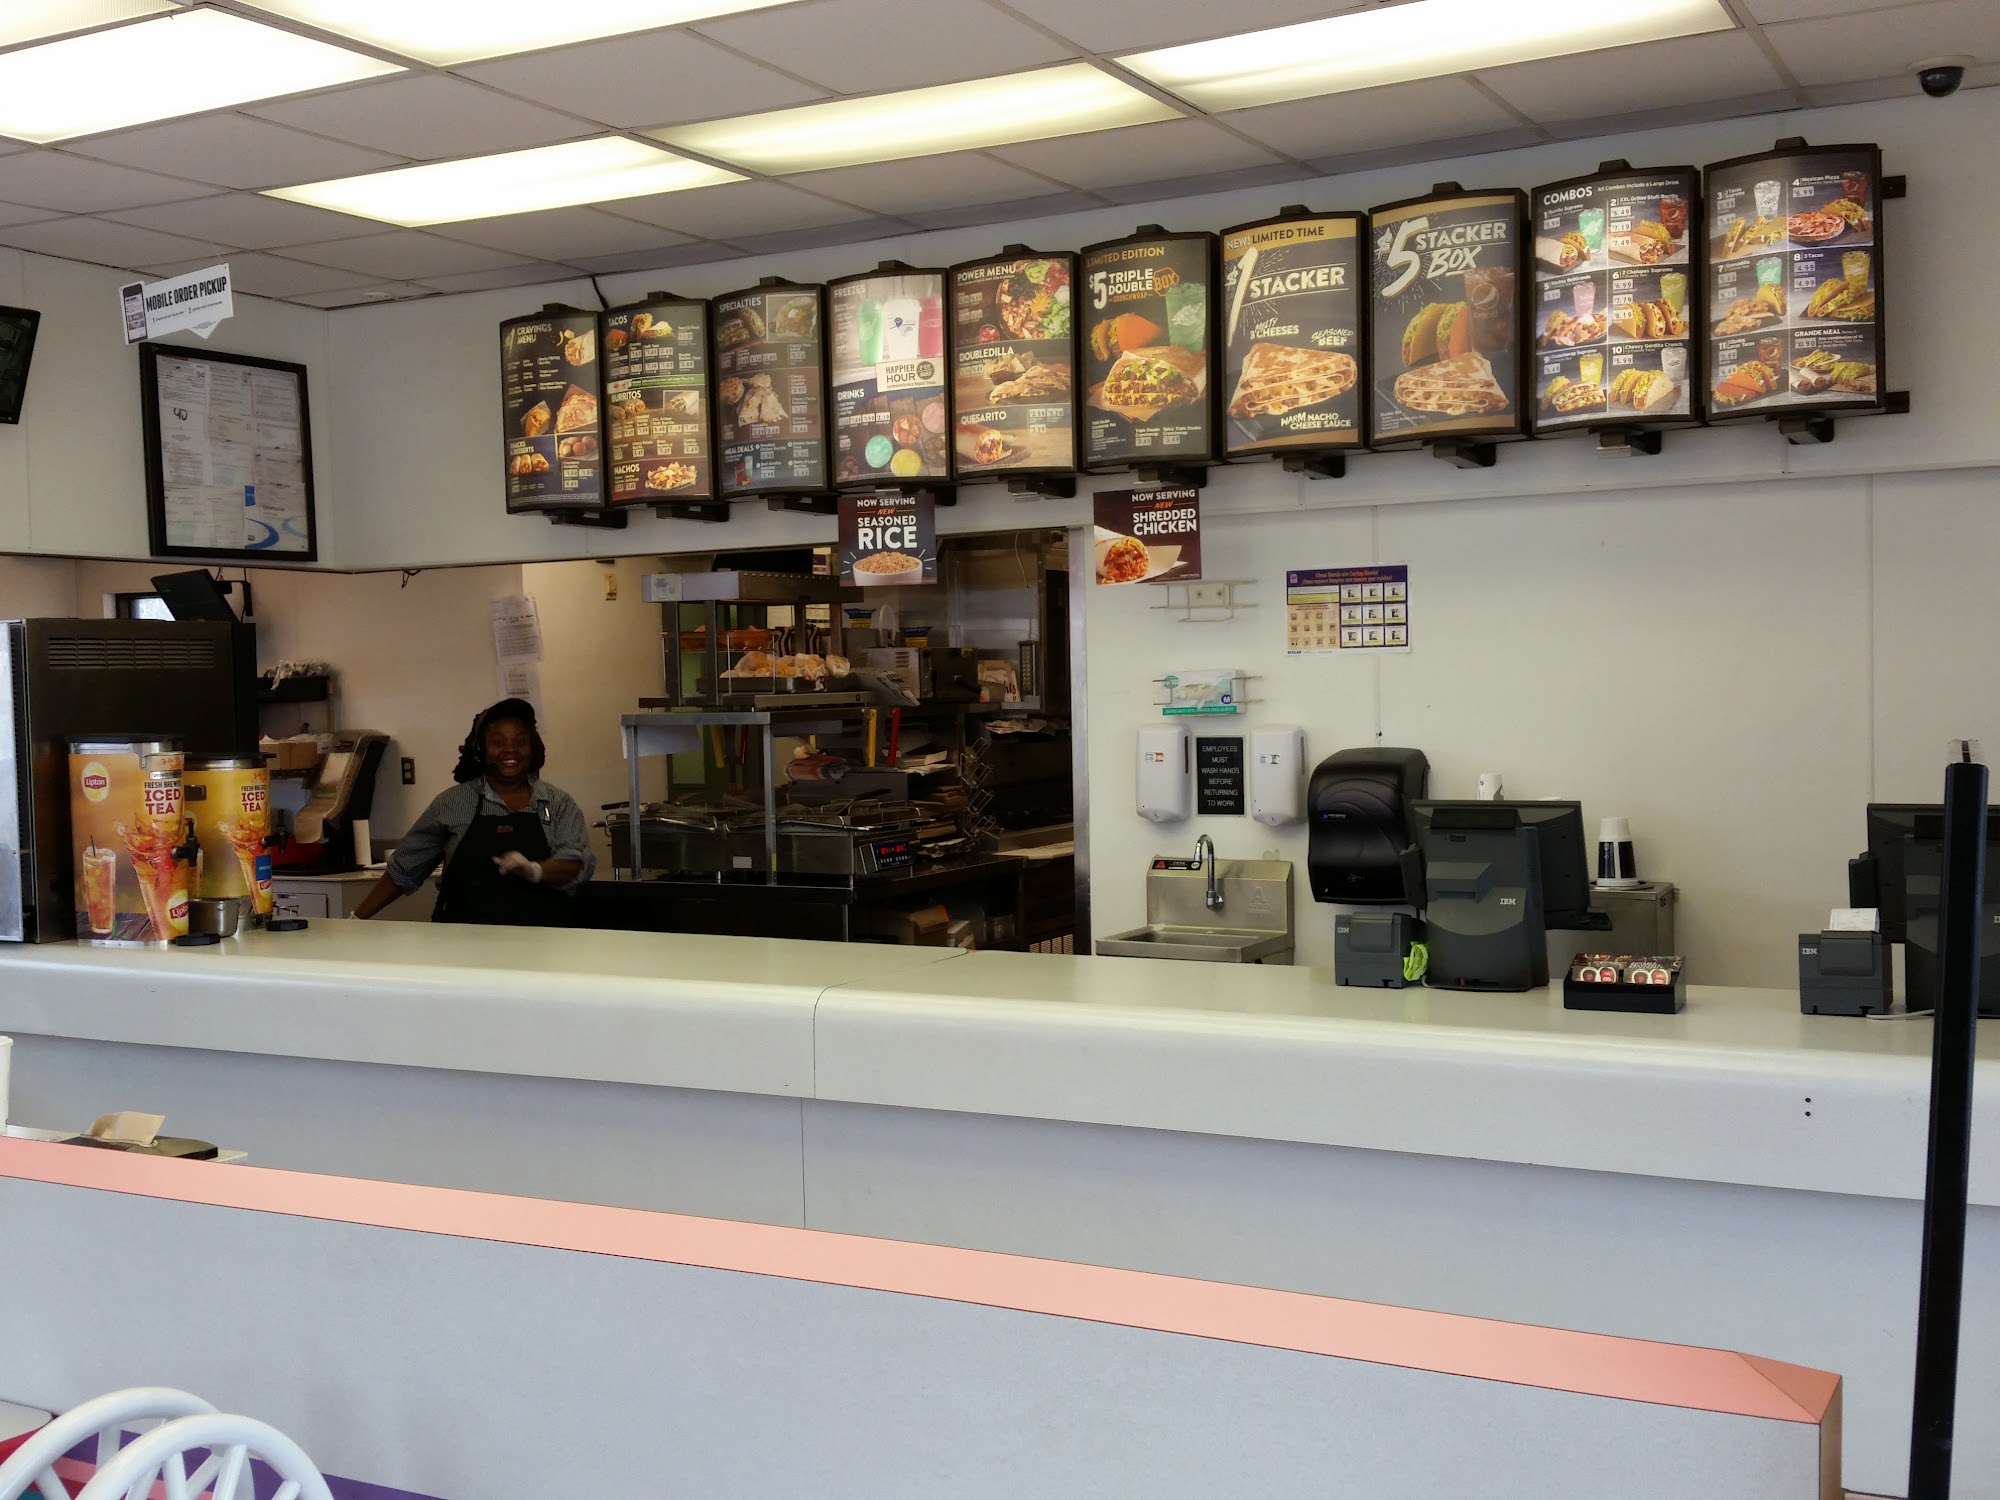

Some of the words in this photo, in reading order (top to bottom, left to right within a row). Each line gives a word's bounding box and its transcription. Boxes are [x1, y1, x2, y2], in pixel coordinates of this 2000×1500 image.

[1544, 186, 1592, 205] COMBOS
[1226, 236, 1250, 250] NEW!
[1252, 229, 1294, 244] LIMITED
[1297, 226, 1324, 237] TIME
[1416, 223, 1506, 250] STACKER
[1087, 252, 1120, 267] LIMITED
[1122, 247, 1165, 260] EDITION
[1374, 216, 1429, 298] $5
[1427, 245, 1482, 279] BOX
[958, 269, 985, 282] POWER
[987, 265, 1016, 277] MENU
[1108, 268, 1153, 284] TRIPLE
[1108, 280, 1153, 296] DOUBLE
[1154, 273, 1175, 290] BOX
[1250, 267, 1345, 299] STACKER
[146, 290, 173, 312] MOBILE
[174, 284, 198, 304] ORDER
[200, 276, 226, 297] PICKUP
[834, 284, 866, 298] FREEZES
[1089, 271, 1107, 309] $5
[1114, 292, 1148, 302] CRUNCHWRAP
[1224, 247, 1259, 348] $1
[720, 297, 762, 313] SPECIALTIES
[609, 315, 628, 326] TACOS
[1255, 318, 1278, 332] MELTY
[517, 324, 552, 336] CRAVINGS
[1250, 330, 1256, 340] 3
[1256, 325, 1299, 339] CHEESES
[1311, 328, 1354, 343] SEASONED
[517, 334, 536, 344] MENU
[1318, 336, 1347, 347] BEEF
[959, 346, 1014, 362] DOUBLEDILLA
[886, 364, 915, 374] HAPPIER
[886, 373, 916, 383] HOUR
[838, 389, 864, 401] DRINKS
[961, 411, 1006, 424] QUESARITO
[1281, 412, 1306, 427] WARM
[1308, 413, 1339, 421] NACHO
[1290, 421, 1322, 430] CHEESE
[1324, 420, 1351, 428] SAUCE
[614, 464, 640, 474] NACHOS
[857, 499, 877, 508] NOW
[880, 497, 915, 506] SERVING
[1132, 492, 1154, 502] NOW
[1156, 489, 1195, 500] SERVING
[1154, 501, 1174, 509] NEW
[858, 515, 916, 527] SEASONED
[1133, 508, 1196, 523] SHREDDED
[1133, 519, 1197, 535] CHICKEN
[858, 526, 917, 550] RICE
[85, 778, 106, 787] Lipton
[145, 788, 180, 802] ICED
[242, 791, 265, 802] ICED
[146, 802, 175, 815] TEA
[242, 802, 261, 812] TEA
